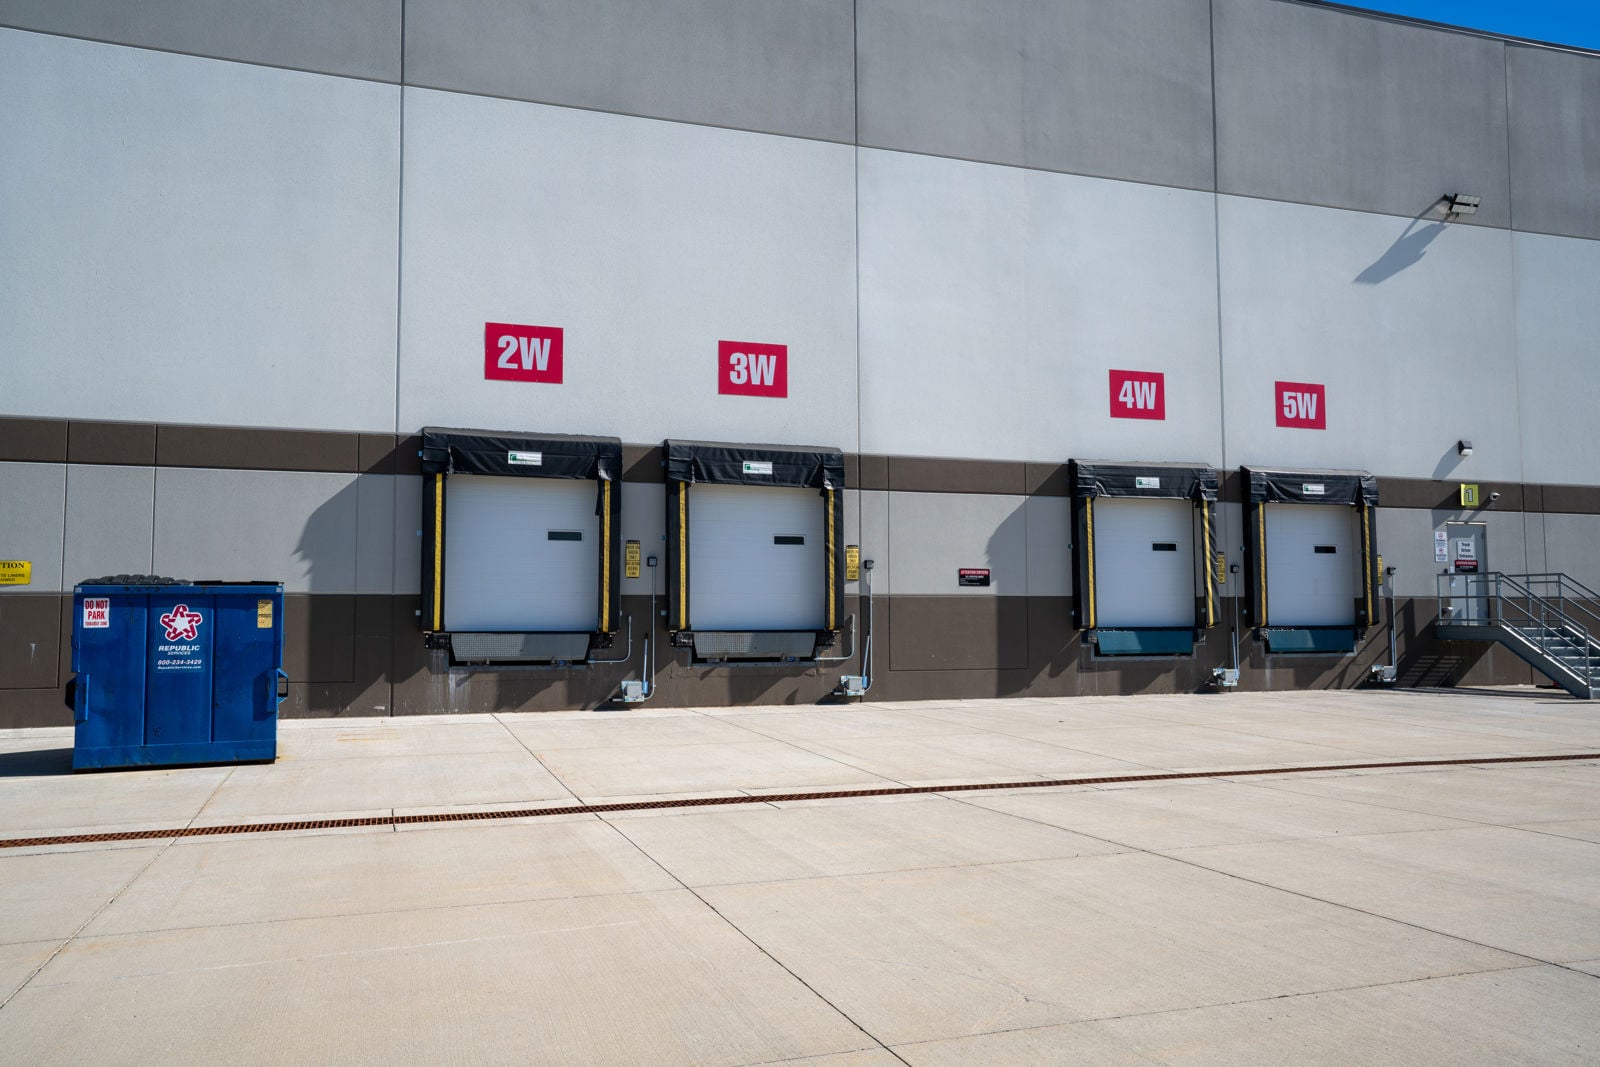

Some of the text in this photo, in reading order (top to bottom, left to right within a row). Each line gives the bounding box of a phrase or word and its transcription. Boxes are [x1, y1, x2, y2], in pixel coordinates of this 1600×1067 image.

[497, 334, 551, 371] 2W
[729, 352, 776, 386] 3W
[1119, 380, 1157, 411] 4W
[1283, 391, 1318, 420] 5W
[1466, 488, 1473, 502] 1
[85, 600, 108, 609] DO NOT
[88, 611, 105, 620] PARK
